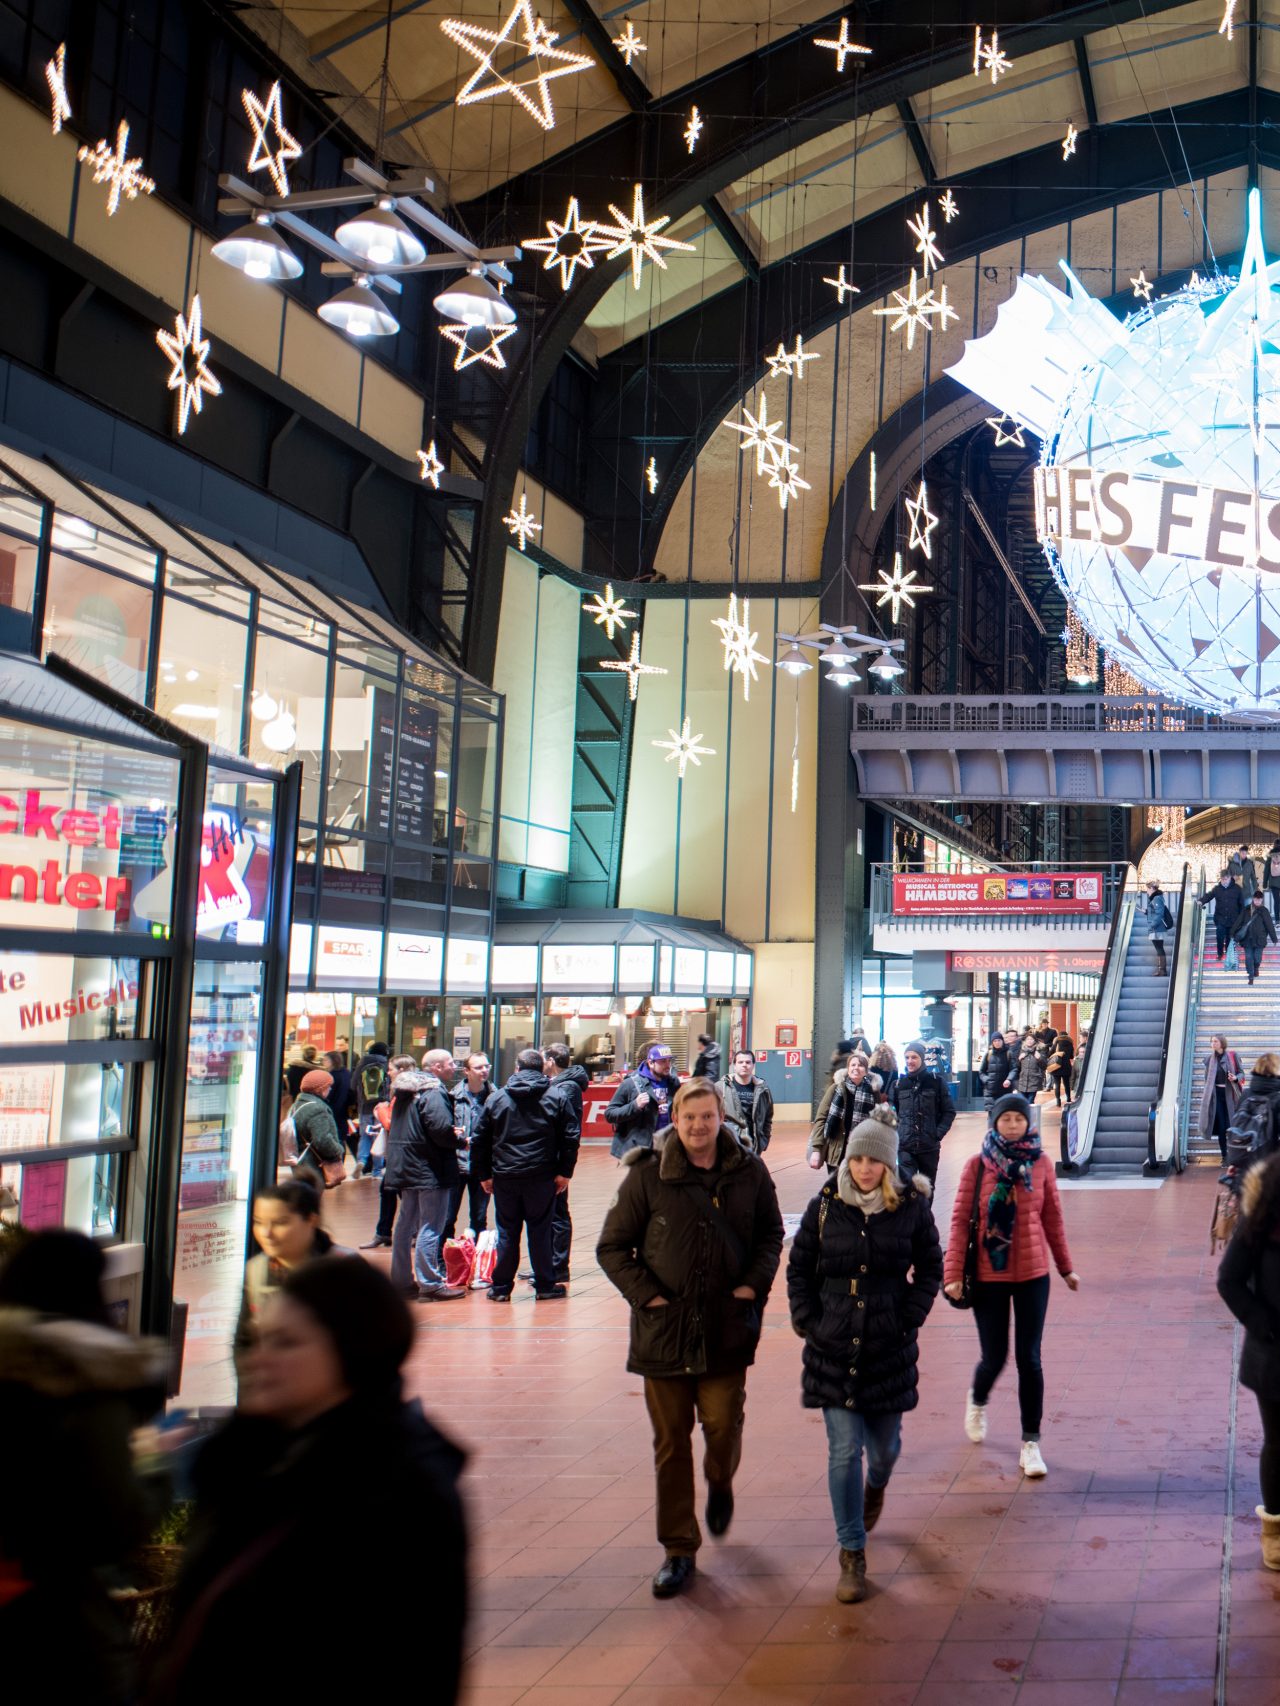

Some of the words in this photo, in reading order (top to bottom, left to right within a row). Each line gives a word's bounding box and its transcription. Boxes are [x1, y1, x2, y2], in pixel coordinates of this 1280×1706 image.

[0, 859, 130, 911] nter
[905, 889, 979, 901] HAMBURG
[332, 942, 364, 956] SPAR
[954, 956, 1040, 968] ROSSMANN
[19, 978, 140, 1031] Musicals
